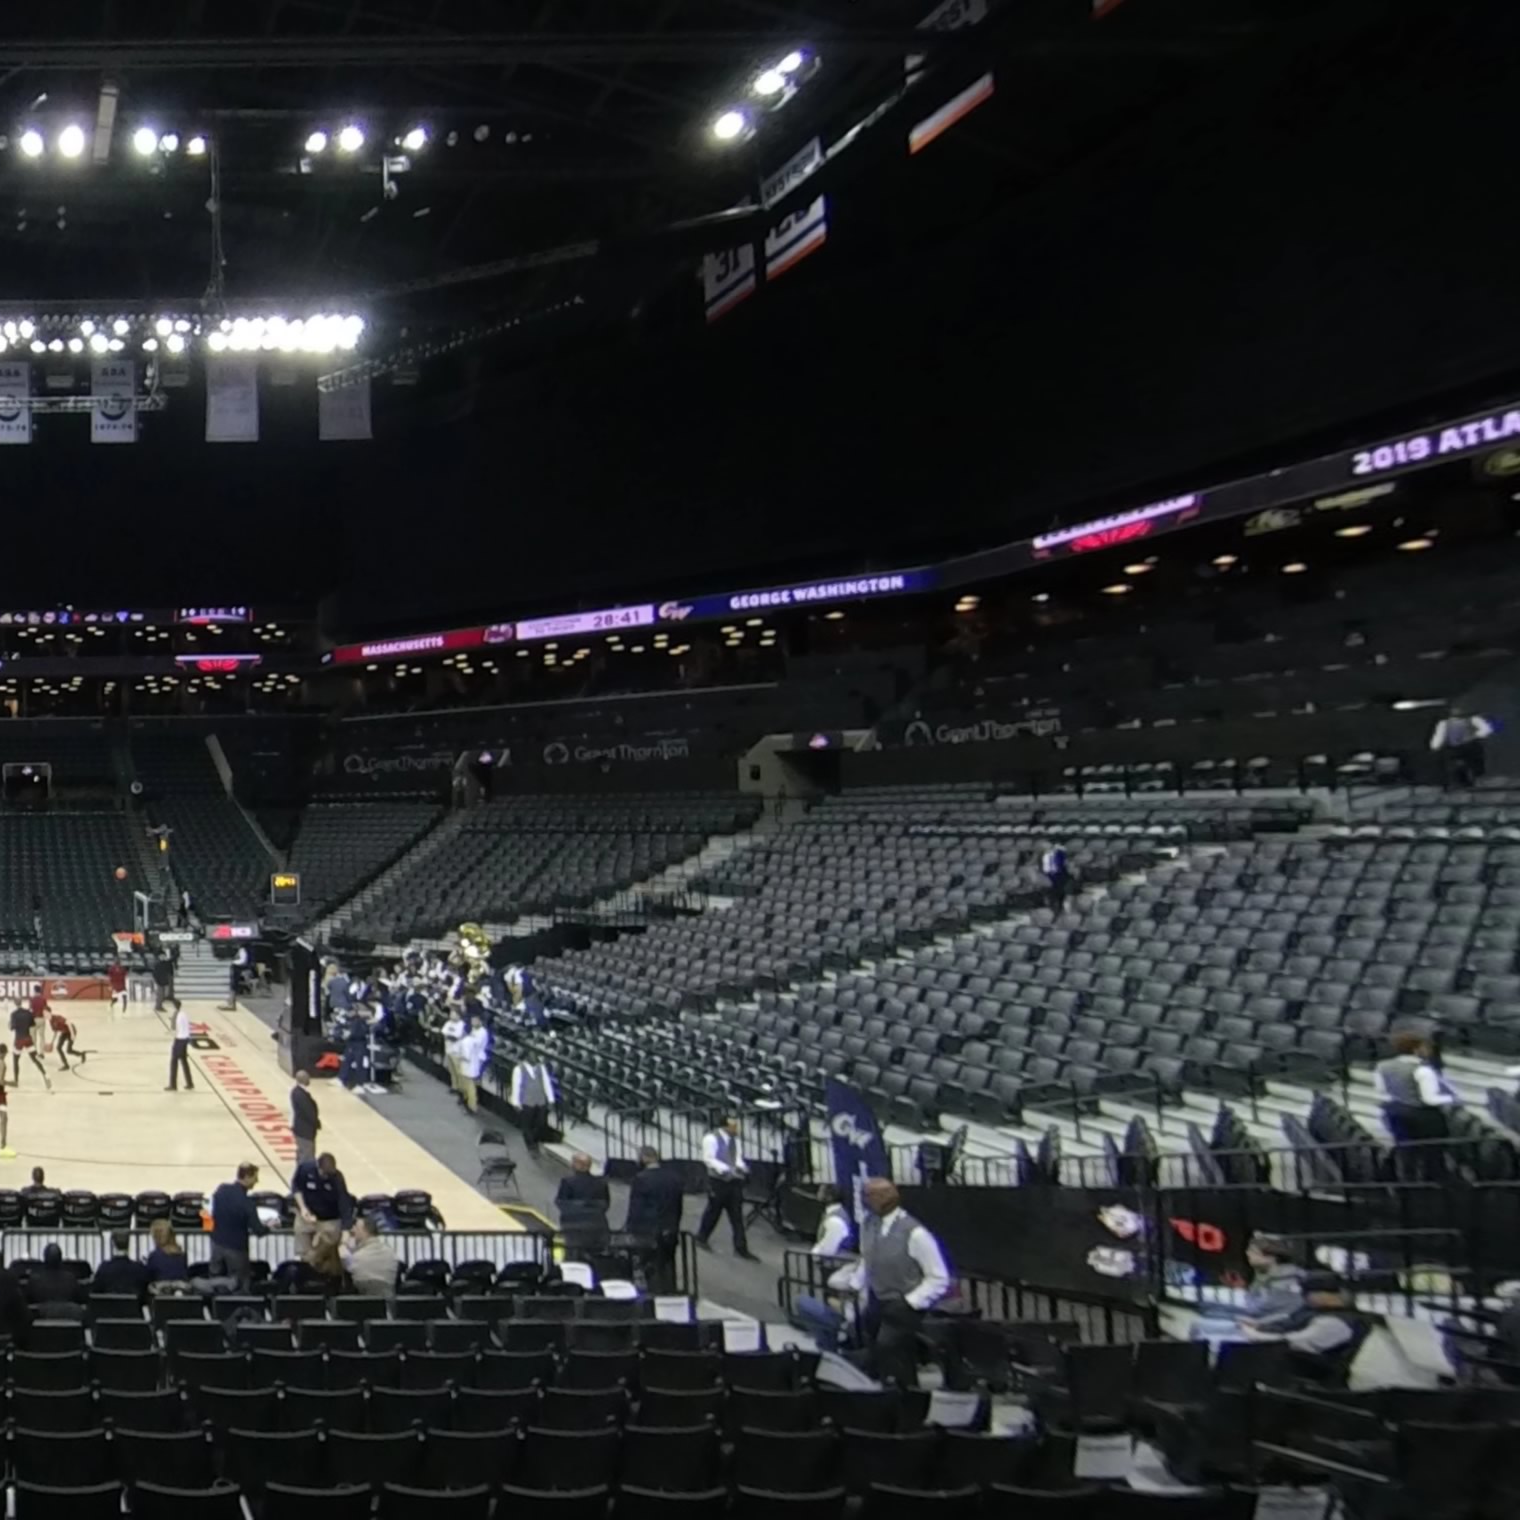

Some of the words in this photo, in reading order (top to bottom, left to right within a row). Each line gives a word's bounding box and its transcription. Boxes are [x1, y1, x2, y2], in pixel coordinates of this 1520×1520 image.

[1350, 436, 1431, 475] 2019
[730, 590, 792, 610] GEORGE
[793, 575, 905, 602] WASHINGTON
[593, 610, 641, 629] 28:41
[361, 635, 445, 657] MASSACHUSETTS
[574, 746, 617, 762] Grant
[618, 740, 689, 760] Thornton
[831, 1112, 873, 1149] GW
